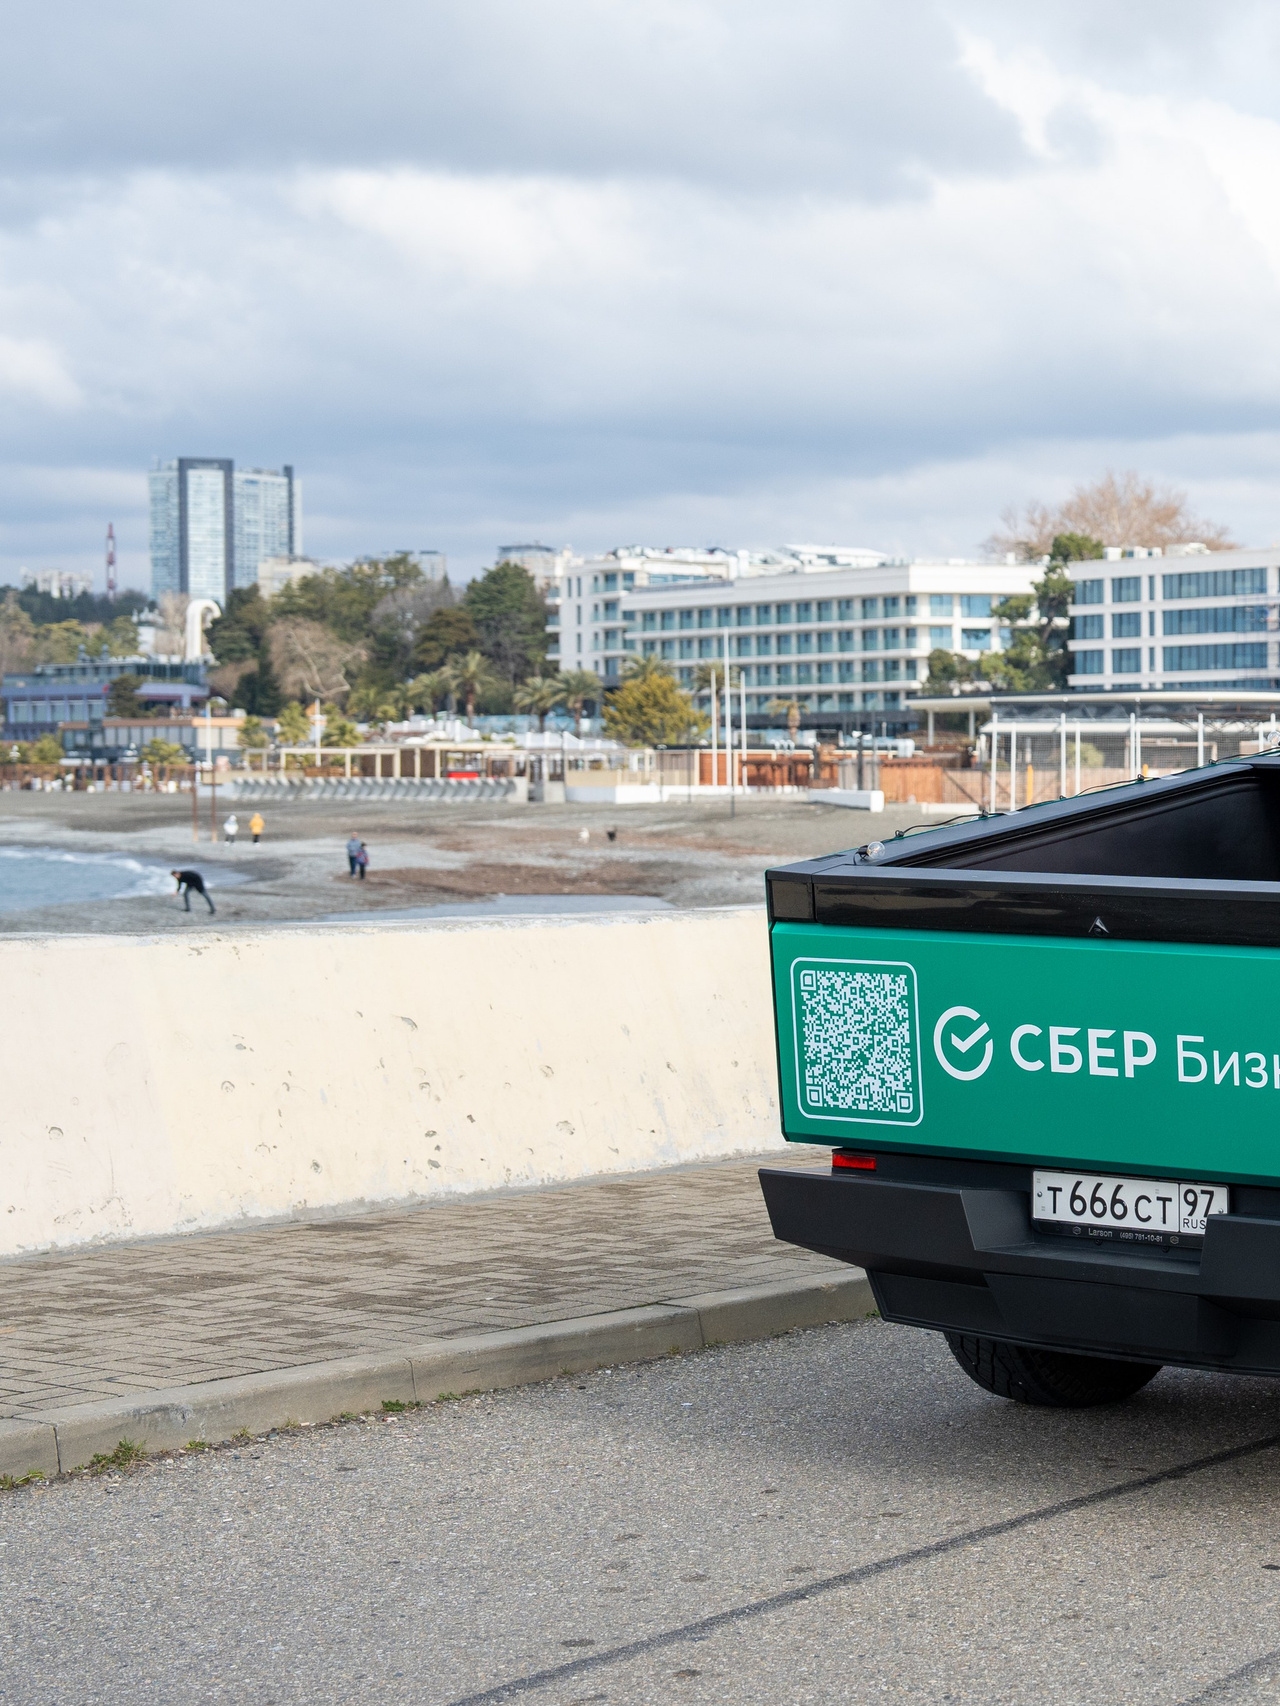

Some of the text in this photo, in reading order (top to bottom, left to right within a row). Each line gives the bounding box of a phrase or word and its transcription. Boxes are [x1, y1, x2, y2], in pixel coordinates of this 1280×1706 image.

[1010, 1023, 1158, 1079] СБЕР
[1183, 1188, 1215, 1219] 97
[1088, 1227, 1113, 1238] Larson
[1183, 1218, 1207, 1230] RUS
